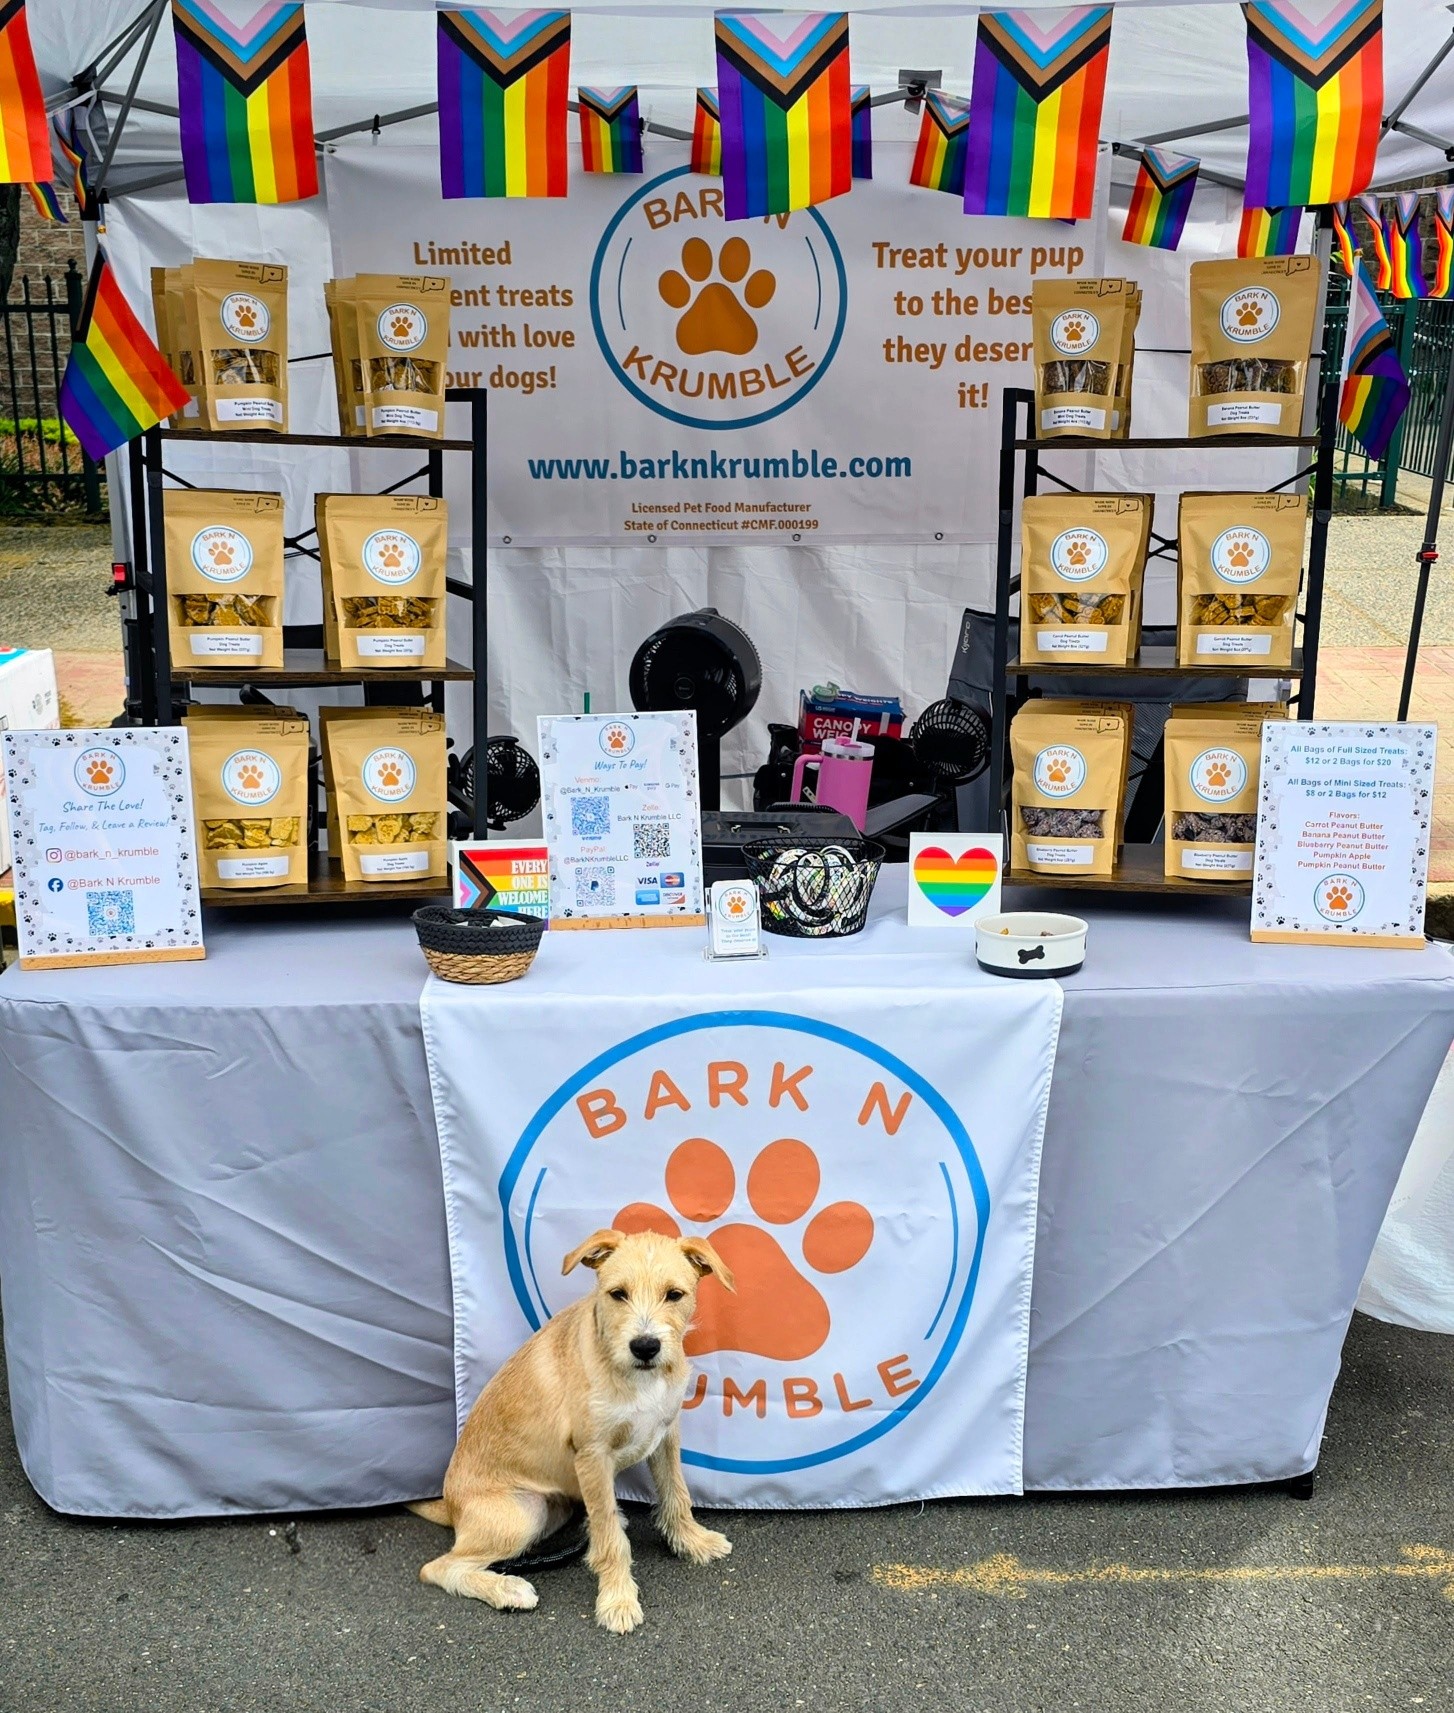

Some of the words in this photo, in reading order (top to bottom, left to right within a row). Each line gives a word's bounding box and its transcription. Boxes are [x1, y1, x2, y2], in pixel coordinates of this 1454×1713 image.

[643, 188, 724, 230] BAR
[413, 240, 512, 265] Limited
[871, 241, 948, 269] Treat
[954, 246, 1023, 276] your
[1029, 246, 1084, 275] pup
[497, 285, 574, 307] treats
[894, 291, 924, 316] to
[931, 288, 979, 316] the
[988, 287, 1033, 316] bes
[1234, 292, 1258, 302] BARK
[458, 324, 516, 348] with
[524, 323, 575, 348] love
[1226, 323, 1271, 336] KRUMBLE
[384, 334, 419, 346] KRUMBLE
[883, 335, 947, 369] they
[954, 334, 1033, 362] deser
[445, 370, 483, 389] our
[489, 364, 557, 394] dogs!
[622, 345, 816, 400] KRUMBLE
[957, 382, 989, 408] it!
[527, 449, 912, 480] www.barknkrumble.com
[631, 502, 681, 513] Licensed
[683, 503, 702, 513] Pet
[705, 502, 732, 513] Food
[734, 502, 812, 513] Manufacturer
[624, 520, 655, 531] State
[656, 520, 669, 531] of
[670, 519, 739, 531] Connecticut
[741, 519, 819, 530] #CMF.000199
[202, 532, 227, 542] BARK
[374, 535, 398, 544] BARK
[1065, 533, 1088, 541] BARK
[1225, 532, 1250, 541] BARK
[202, 562, 246, 575] KRUMBLE
[372, 566, 414, 577] KRUMBLE
[1058, 563, 1098, 575] KRUMBLE
[1217, 564, 1262, 577] KRUMBLE
[1046, 749, 1070, 757] BARK
[1304, 746, 1324, 754] Bags
[1205, 753, 1229, 761] BARK
[1340, 758, 1360, 766] Bags
[595, 761, 616, 770] Ways
[630, 759, 647, 769] Pay!
[1037, 778, 1077, 792] KRUMBLE
[1195, 783, 1238, 796] KRUMBLE
[1301, 779, 1321, 787] Bags
[1336, 791, 1356, 799] Bags
[62, 801, 94, 813] Share
[97, 800, 116, 811] The
[119, 798, 144, 811] Love!
[39, 822, 56, 834] Tag,
[59, 821, 87, 832] Follow,
[91, 820, 100, 830] &
[102, 820, 127, 830] Leave
[128, 821, 135, 829] a
[137, 818, 170, 828] Review!
[1298, 841, 1334, 849] Blueberry
[64, 847, 159, 861] @bark_n_krumble
[512, 860, 547, 874] EVERY
[67, 878, 103, 890] @Bark
[106, 877, 115, 886] N
[118, 875, 160, 886] Krumble
[513, 876, 533, 890] ONE
[538, 876, 548, 888] IS
[638, 876, 658, 884] VISA
[500, 891, 548, 905] WELCOME
[518, 906, 548, 918] HERE
[575, 1060, 813, 1139] BARK
[857, 1081, 913, 1136] N
[682, 1353, 921, 1419] UMBLE
